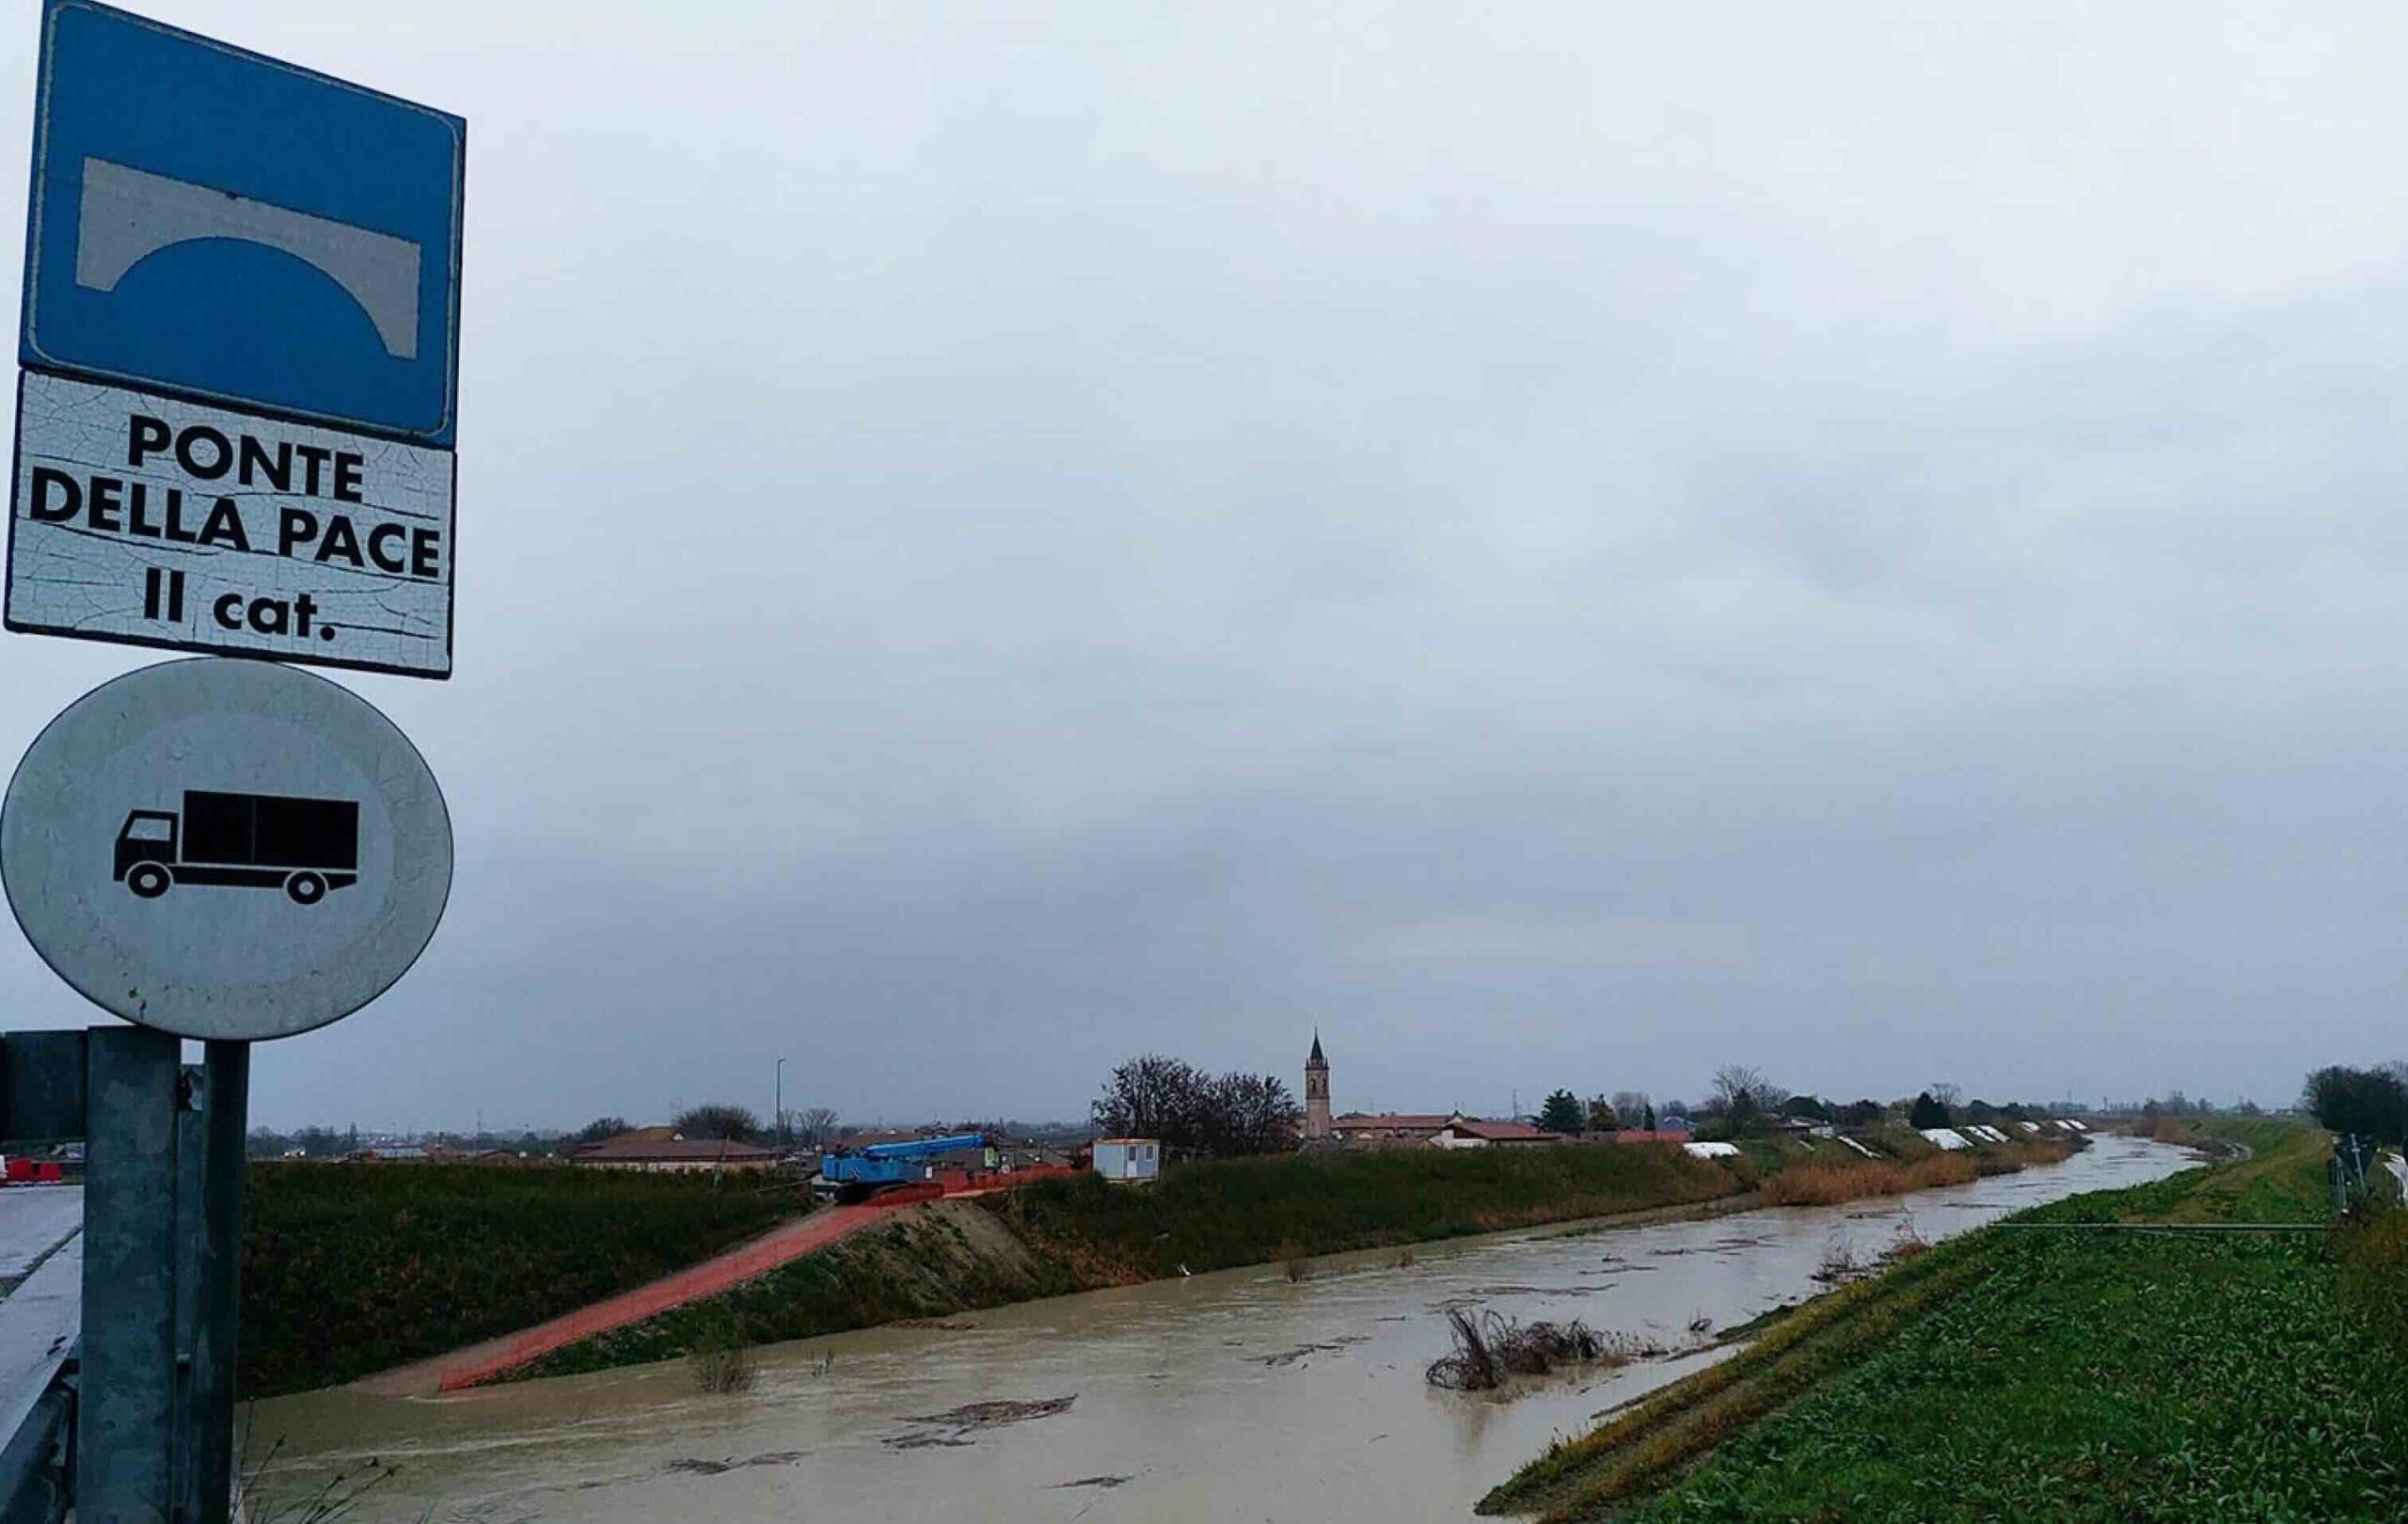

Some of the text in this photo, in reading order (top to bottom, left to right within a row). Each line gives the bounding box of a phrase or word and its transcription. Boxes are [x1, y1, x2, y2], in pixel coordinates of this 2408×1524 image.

[130, 414, 363, 503] PONTE
[30, 466, 439, 578] DELLA PACE
[144, 566, 336, 642] II cat.
